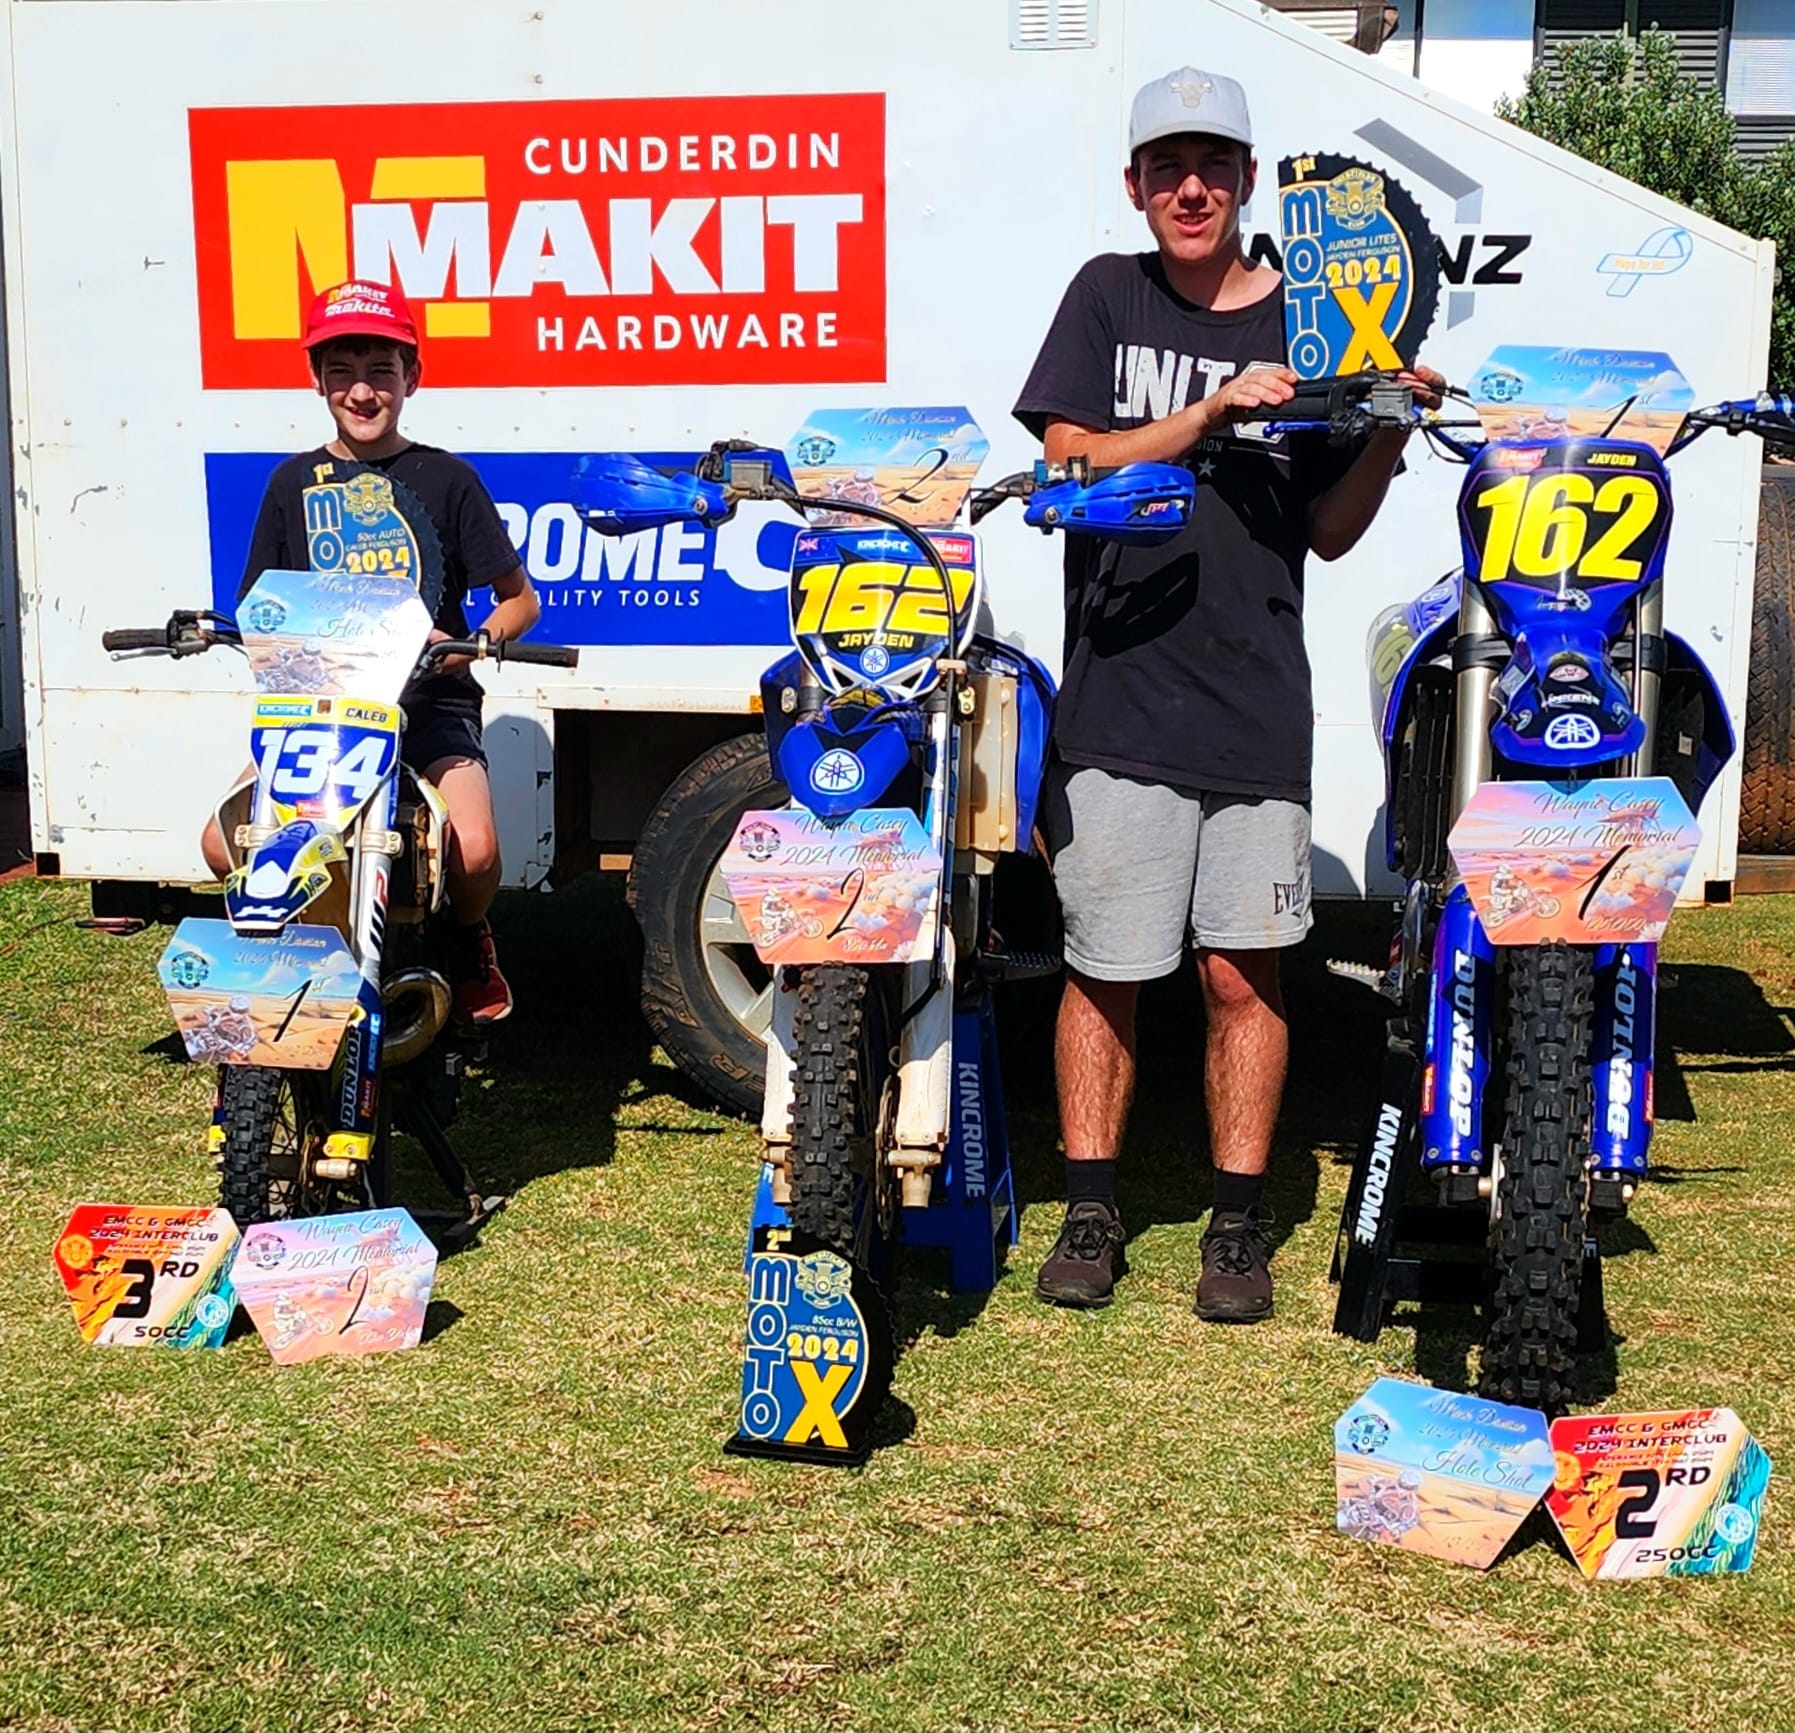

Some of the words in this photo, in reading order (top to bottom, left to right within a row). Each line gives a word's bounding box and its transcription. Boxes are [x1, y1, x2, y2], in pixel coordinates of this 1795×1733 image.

[524, 133, 841, 174] CUNDERDIN
[351, 194, 864, 298] MAKIT
[1327, 235, 1367, 252] JUNIOR
[1369, 232, 1397, 246] LITES
[1326, 254, 1401, 288] 2024
[538, 313, 839, 352] HARDWARE
[1332, 281, 1404, 377] X
[1114, 343, 1237, 421] UNIT
[1587, 453, 1637, 467] JAYDEN
[1477, 473, 1659, 583] 162
[346, 546, 411, 574] 2024
[619, 589, 701, 607] TOOLS
[796, 561, 975, 636] 162
[838, 631, 915, 649] JAYDEN
[346, 707, 388, 723] CALEB
[260, 729, 388, 801] 134
[1514, 825, 1581, 847] 2024
[1583, 825, 1685, 847] Memorial
[779, 844, 836, 866] 2024
[840, 846, 924, 866] Memorial
[1449, 949, 1477, 1138] DUNLOP
[958, 1061, 987, 1200] KINCROME
[1355, 1102, 1402, 1245] KINCROME
[89, 1228, 130, 1240] 2024
[133, 1230, 219, 1242] INTERCLUB
[104, 1215, 144, 1226] EMCC
[165, 1217, 205, 1228] GMCC
[288, 1247, 340, 1272] 2024
[343, 1239, 423, 1265] Memorial
[112, 1258, 200, 1318] 3RD
[134, 1326, 190, 1339] 50CC
[786, 1332, 859, 1363] 2024
[784, 1359, 855, 1447] X
[1574, 1440, 1622, 1453] 2024
[1627, 1434, 1728, 1449] INTERCLUB
[1588, 1423, 1637, 1437] EMCC
[1661, 1419, 1710, 1432] GMCC
[1422, 1450, 1480, 1477] Hole
[1483, 1460, 1537, 1489] Shot
[1616, 1466, 1712, 1539] 2RD
[1636, 1545, 1719, 1563] 250CC
